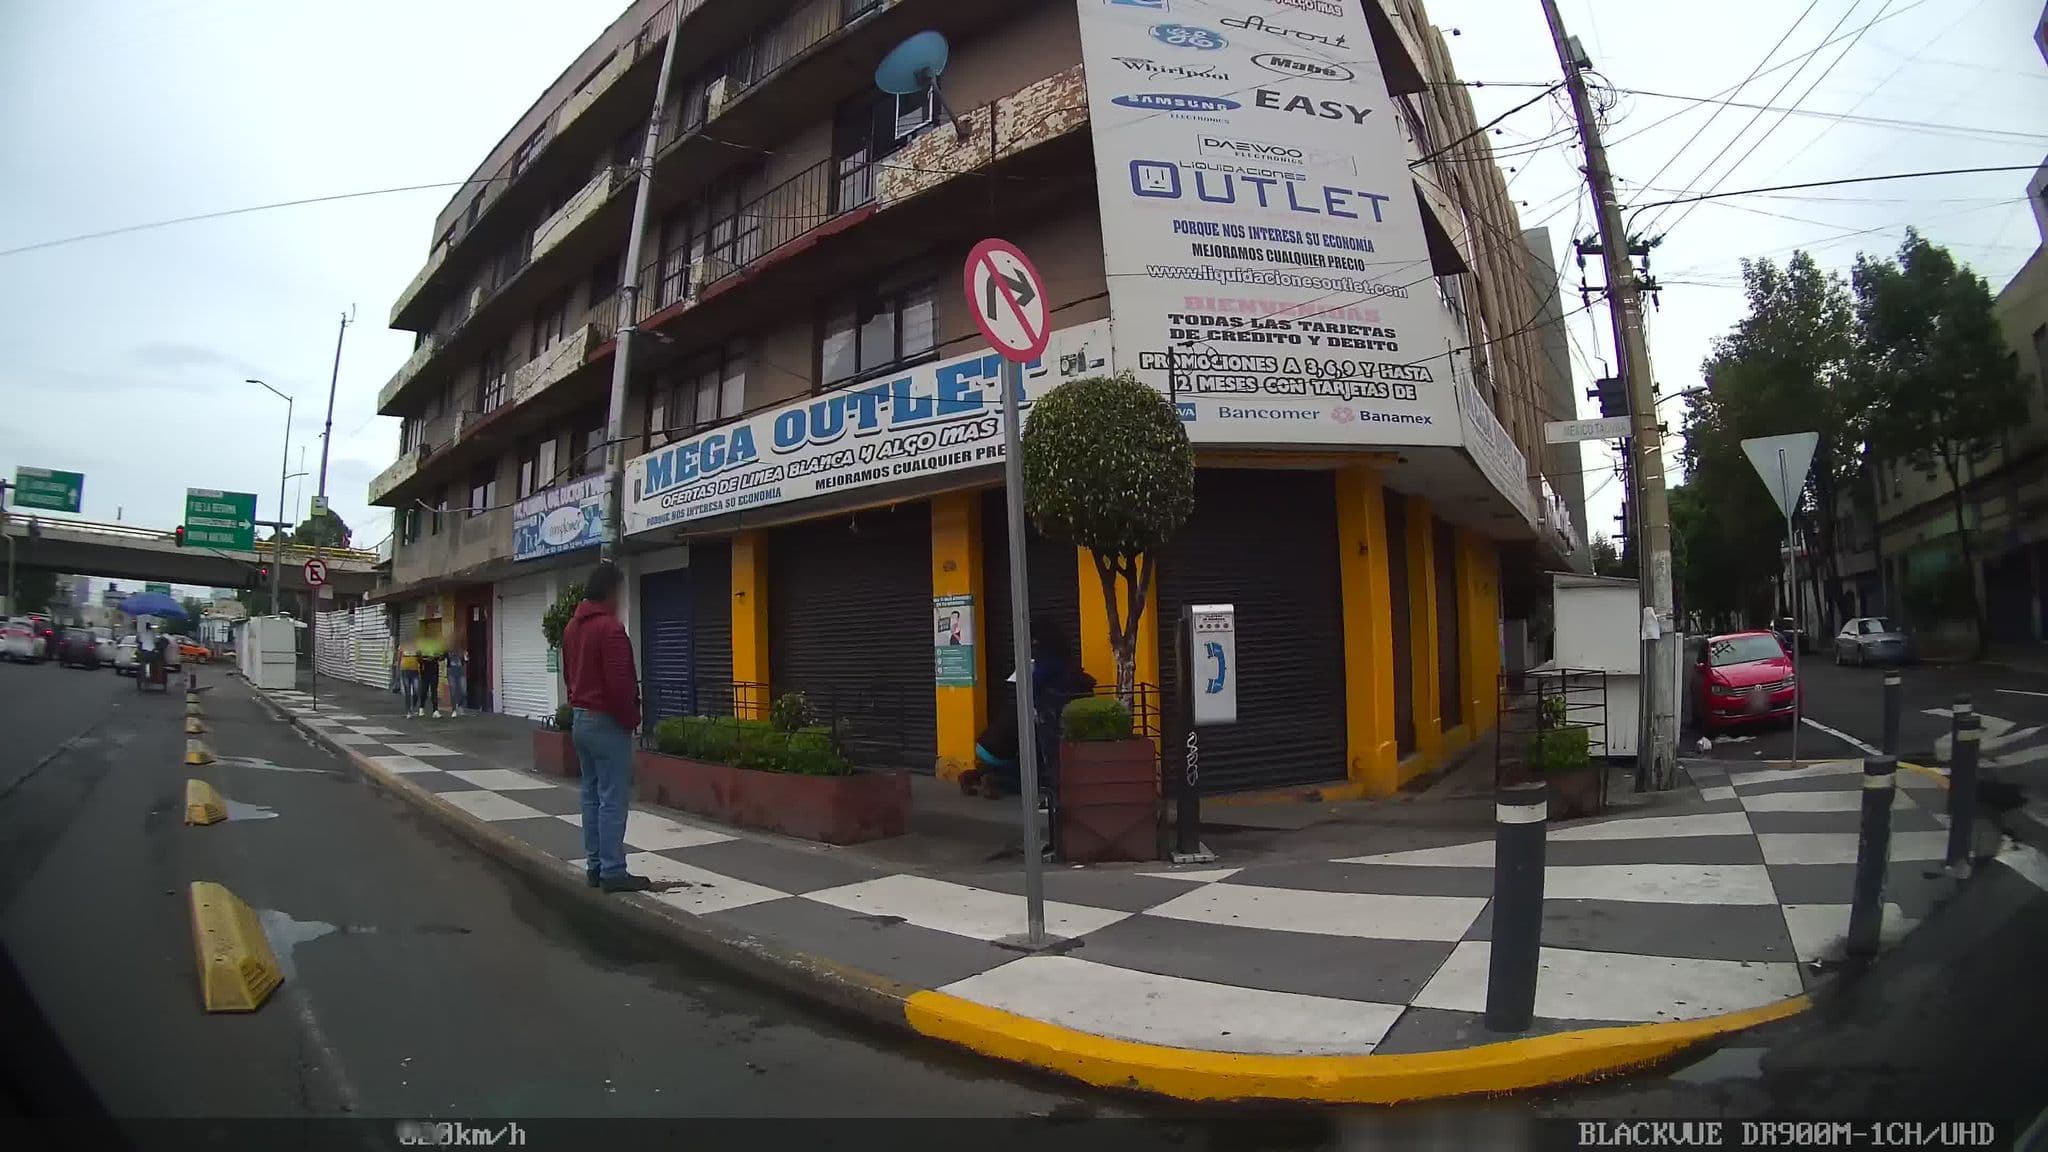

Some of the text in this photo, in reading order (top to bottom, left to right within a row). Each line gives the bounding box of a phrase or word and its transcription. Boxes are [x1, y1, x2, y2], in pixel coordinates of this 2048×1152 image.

[1315, 1, 1344, 17] MAS
[1115, 57, 1230, 81] Whirlpool
[1269, 56, 1338, 78] Mabe
[1127, 95, 1229, 111] SAMSUNG
[1255, 88, 1373, 125] EASY
[1204, 138, 1303, 159] DAEWOO
[1234, 151, 1304, 165] ELECTRONICS
[1129, 159, 1390, 223] OUTLET
[1173, 219, 1220, 237] PORQUE
[1223, 223, 1246, 239] NOS
[1248, 225, 1304, 245] INTERESA
[1306, 230, 1320, 246] SU
[1191, 243, 1366, 272] MEJORAMOS CUALQUIER PRECIO
[1146, 264, 1409, 299] www.liquidacionesoutlet.com
[1167, 313, 1396, 339] TODAS LAS TARJETAS
[1169, 328, 1399, 352] DE CREDITO Y DEBITO
[1139, 352, 1278, 374] PROMOCIONES
[1282, 356, 1301, 375] A
[1358, 361, 1376, 378] Y
[1379, 364, 1434, 383] HASTA
[1173, 375, 1417, 401] 12 MESES CON TARJETAS DE
[643, 352, 1042, 497] MEGA OUTLET
[1176, 406, 1320, 421] VA Bancomer
[1359, 410, 1433, 426] Banamex
[661, 418, 999, 508] OFERTAS DE LINEA BLANCA Y ALGO MAS
[815, 444, 1006, 491] MEJORAMOS CUALQUIER PRE
[671, 509, 685, 521] NOS
[686, 500, 724, 517] INTERESA
[725, 496, 737, 509] SU
